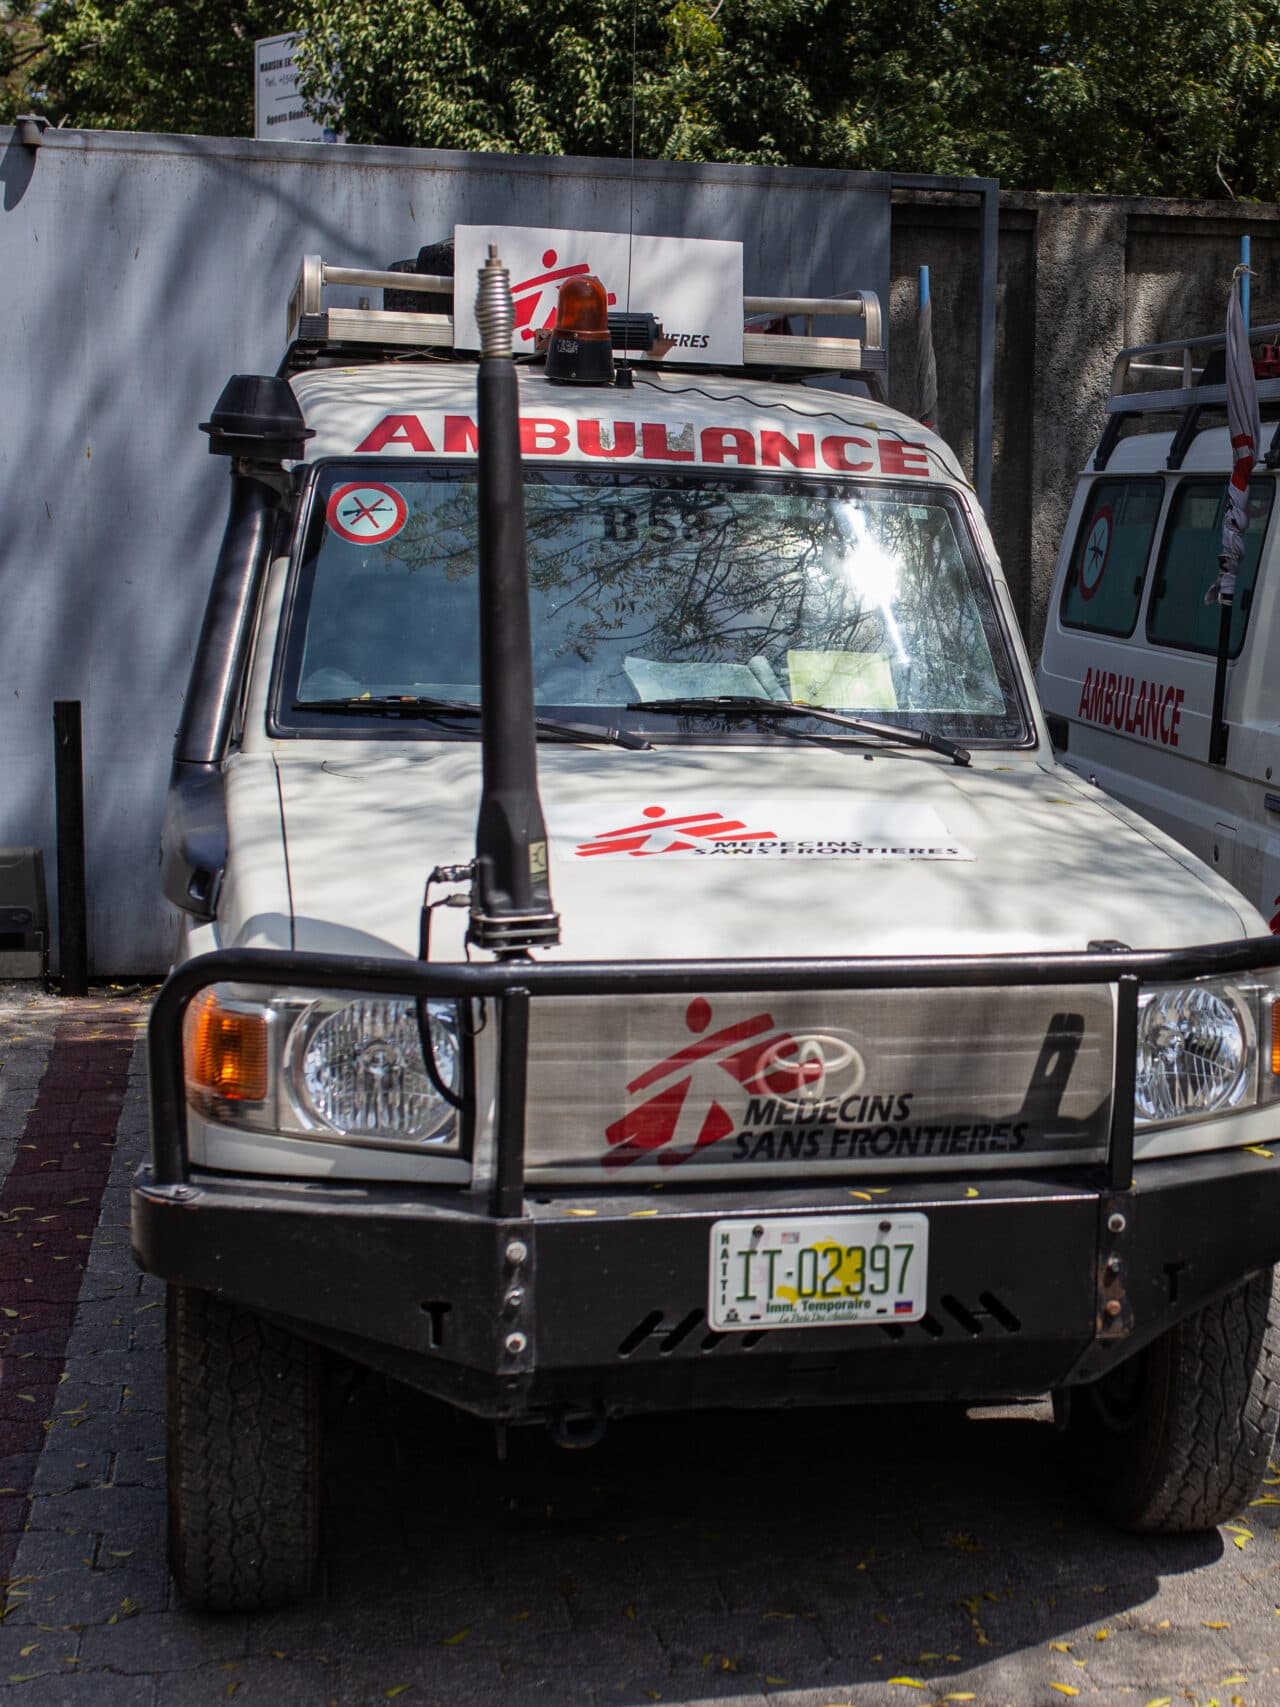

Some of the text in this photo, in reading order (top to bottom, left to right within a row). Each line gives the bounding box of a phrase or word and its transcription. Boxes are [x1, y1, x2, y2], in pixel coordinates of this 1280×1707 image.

[1078, 667, 1185, 747] AMBULANCE
[694, 847, 959, 856] SANS FRONTIERES
[714, 840, 863, 848] MEDECINS
[744, 1093, 913, 1127] MEDECINS
[731, 1122, 1030, 1161] SANS FRONTIERES
[720, 1233, 730, 1306] HAITI
[736, 1243, 915, 1302] IT-02397
[766, 1298, 872, 1313] Imm. Temporaire
